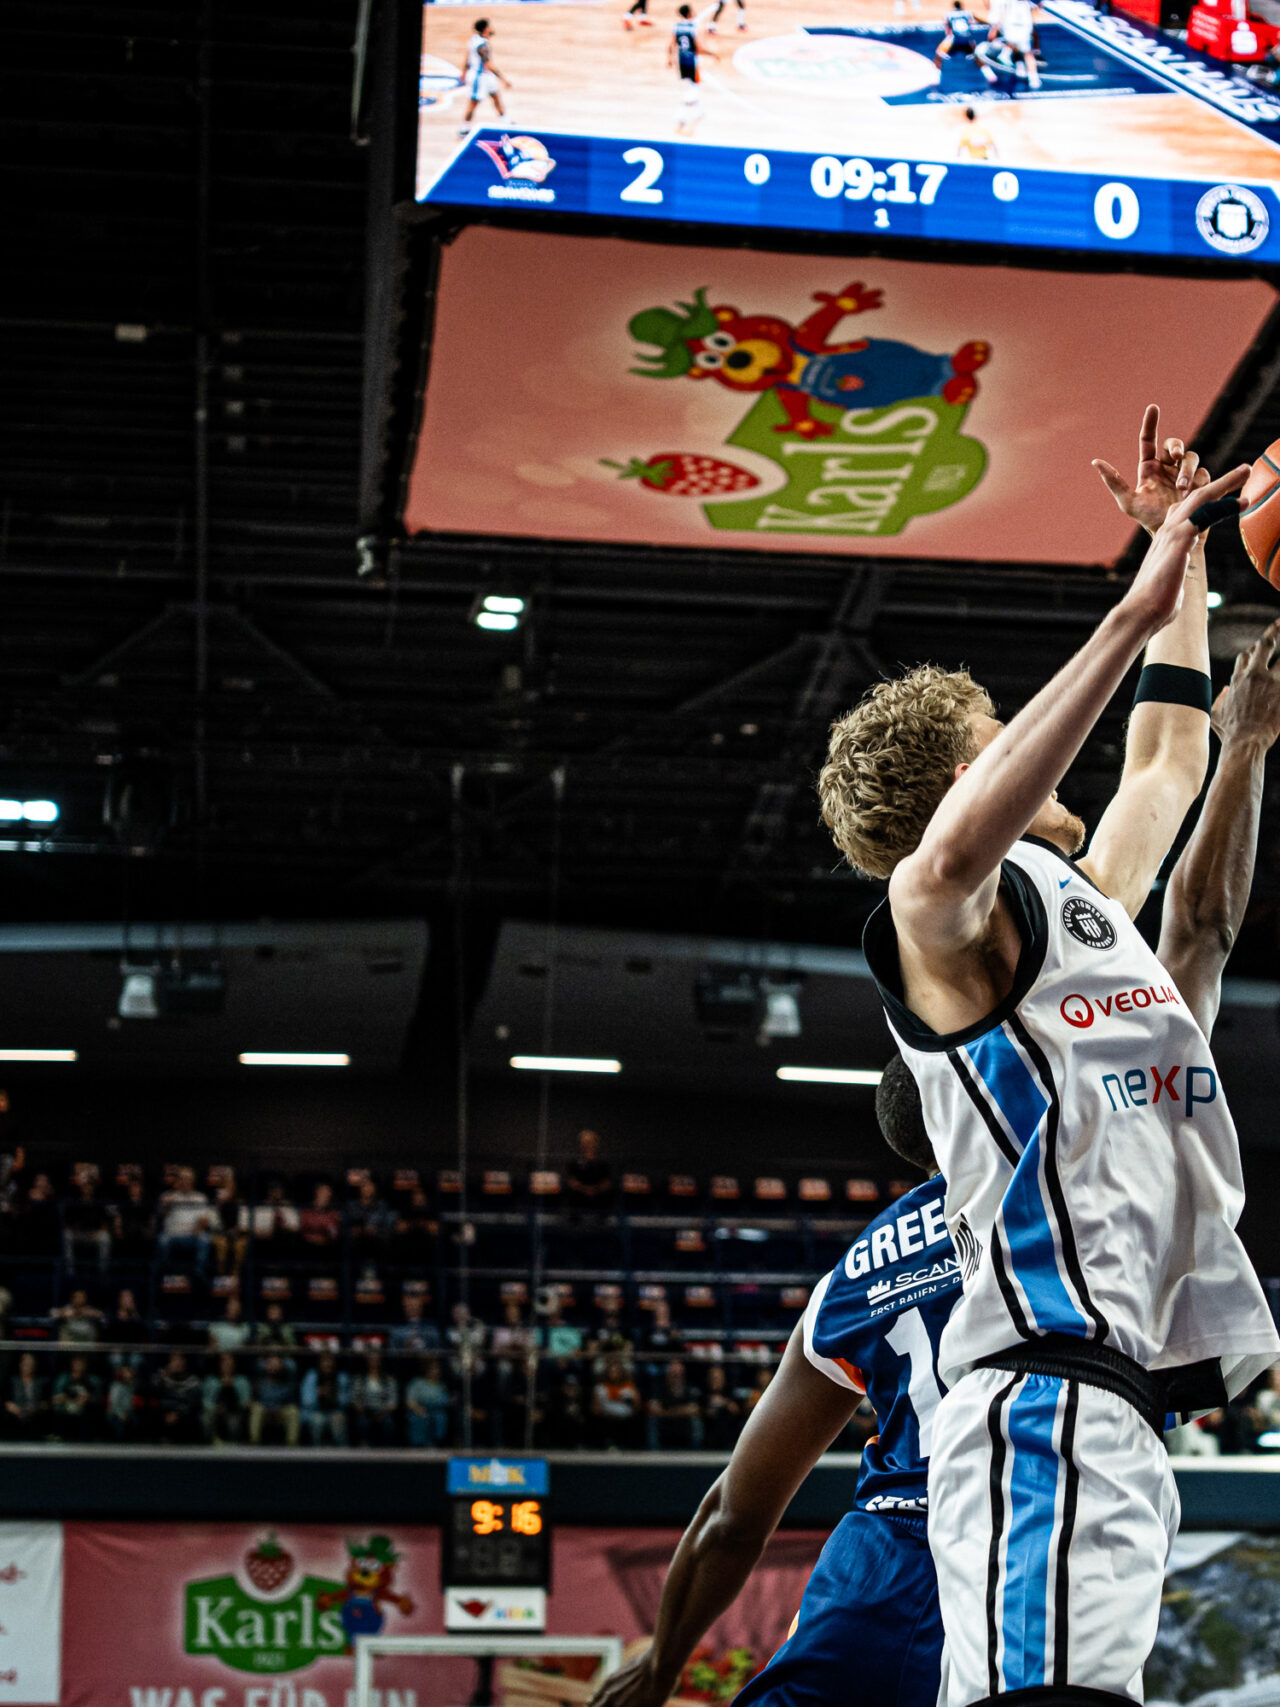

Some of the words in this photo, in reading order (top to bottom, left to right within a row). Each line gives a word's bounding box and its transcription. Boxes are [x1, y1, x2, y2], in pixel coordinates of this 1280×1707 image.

[620, 147, 664, 203] 2
[744, 153, 771, 185] 0
[810, 156, 948, 204] 09:17
[993, 172, 1020, 202] 0
[874, 208, 890, 228] 1
[1094, 182, 1140, 239] 0
[756, 407, 939, 532] Karls
[1095, 985, 1180, 1017] VEOLIA
[1101, 1065, 1217, 1118] nexp
[843, 1197, 949, 1280] GREE
[471, 1500, 543, 1536] 9:16
[194, 1594, 345, 1650] Karls
